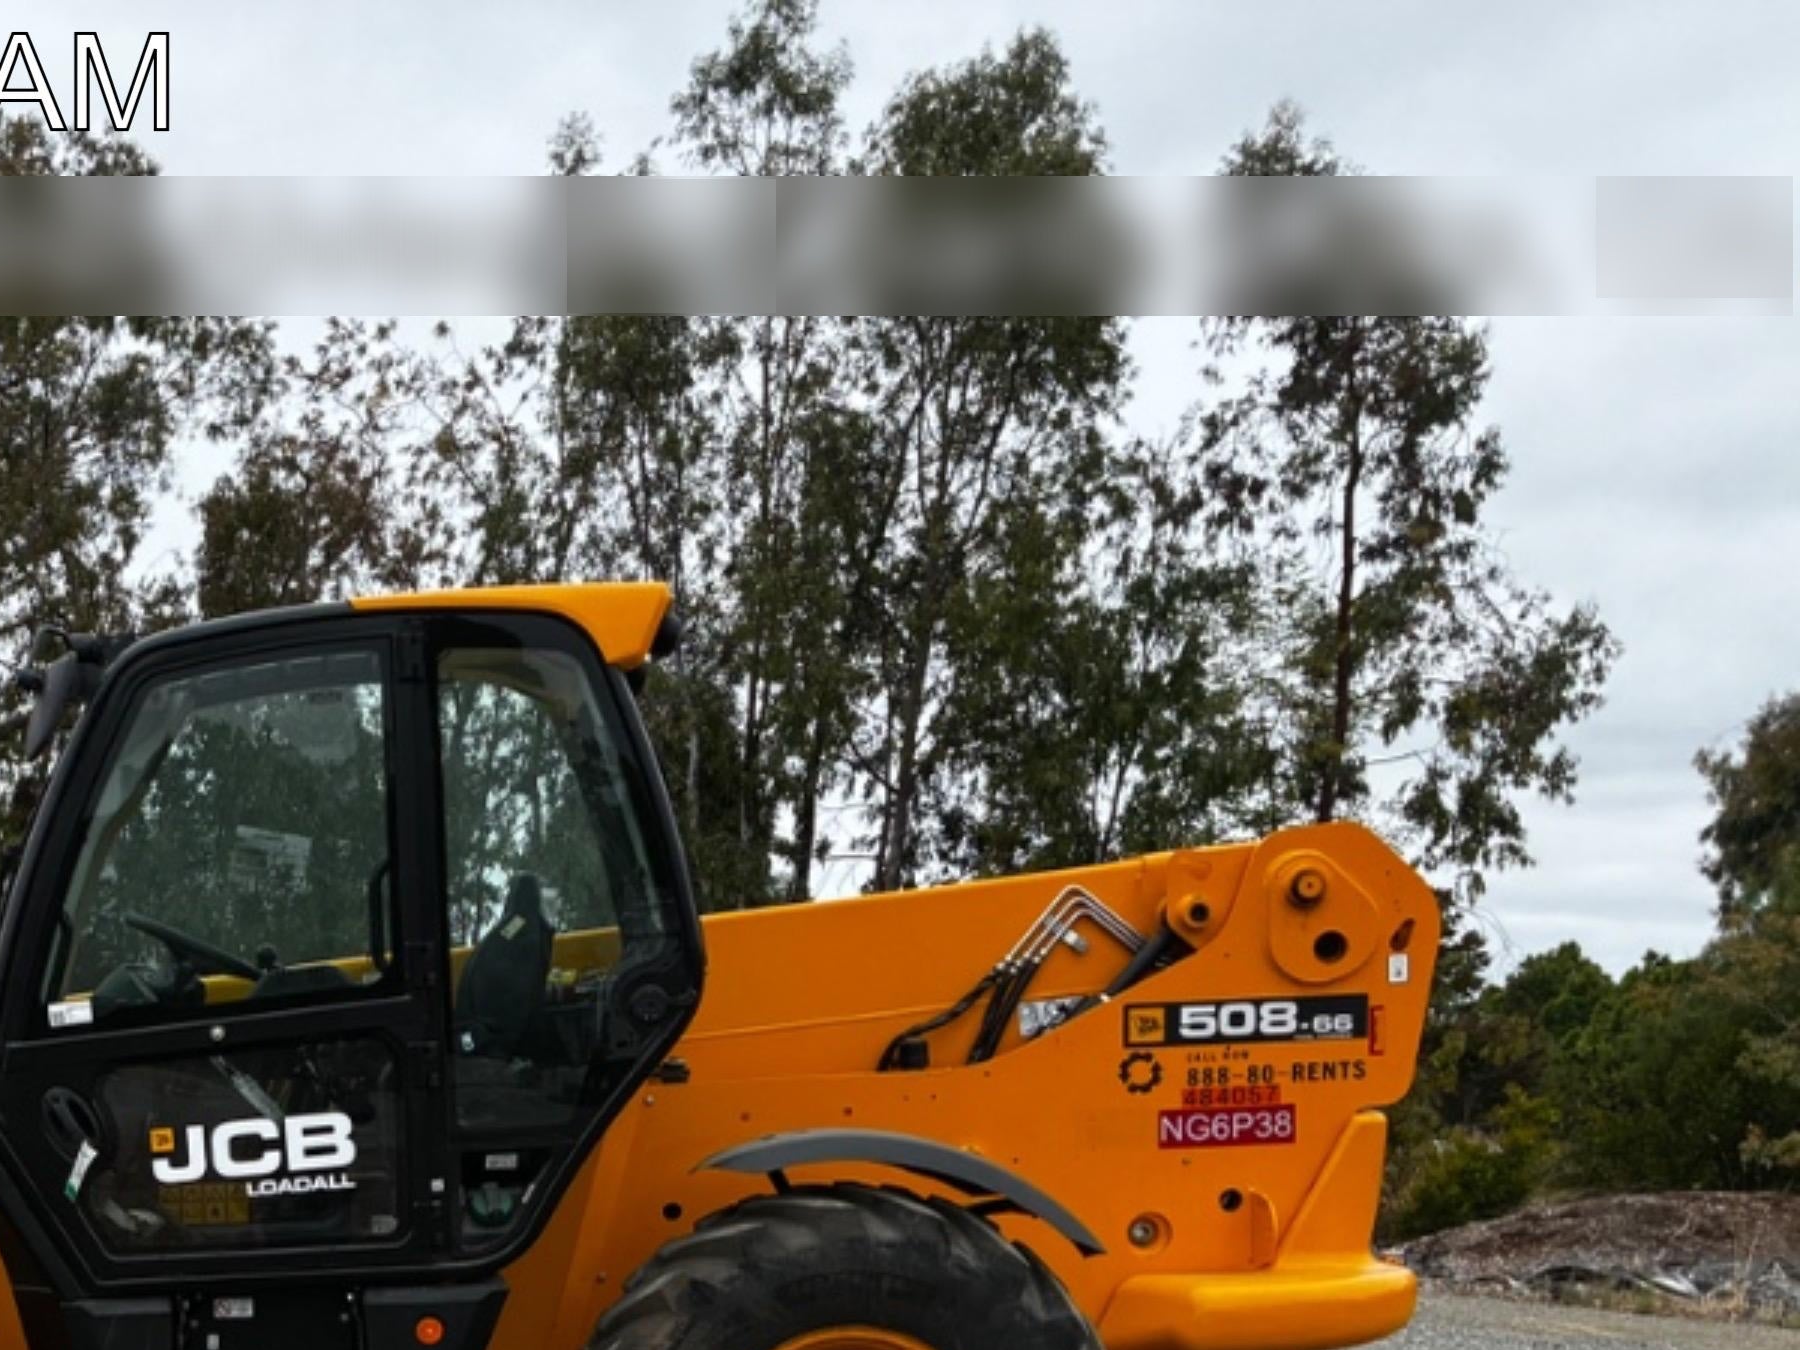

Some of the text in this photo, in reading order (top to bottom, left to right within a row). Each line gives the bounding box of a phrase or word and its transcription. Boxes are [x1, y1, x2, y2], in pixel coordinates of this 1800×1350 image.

[1159, 1110, 1292, 1143] NG6P38
[151, 1112, 356, 1184] JCB
[245, 1172, 358, 1198] LOADALL
